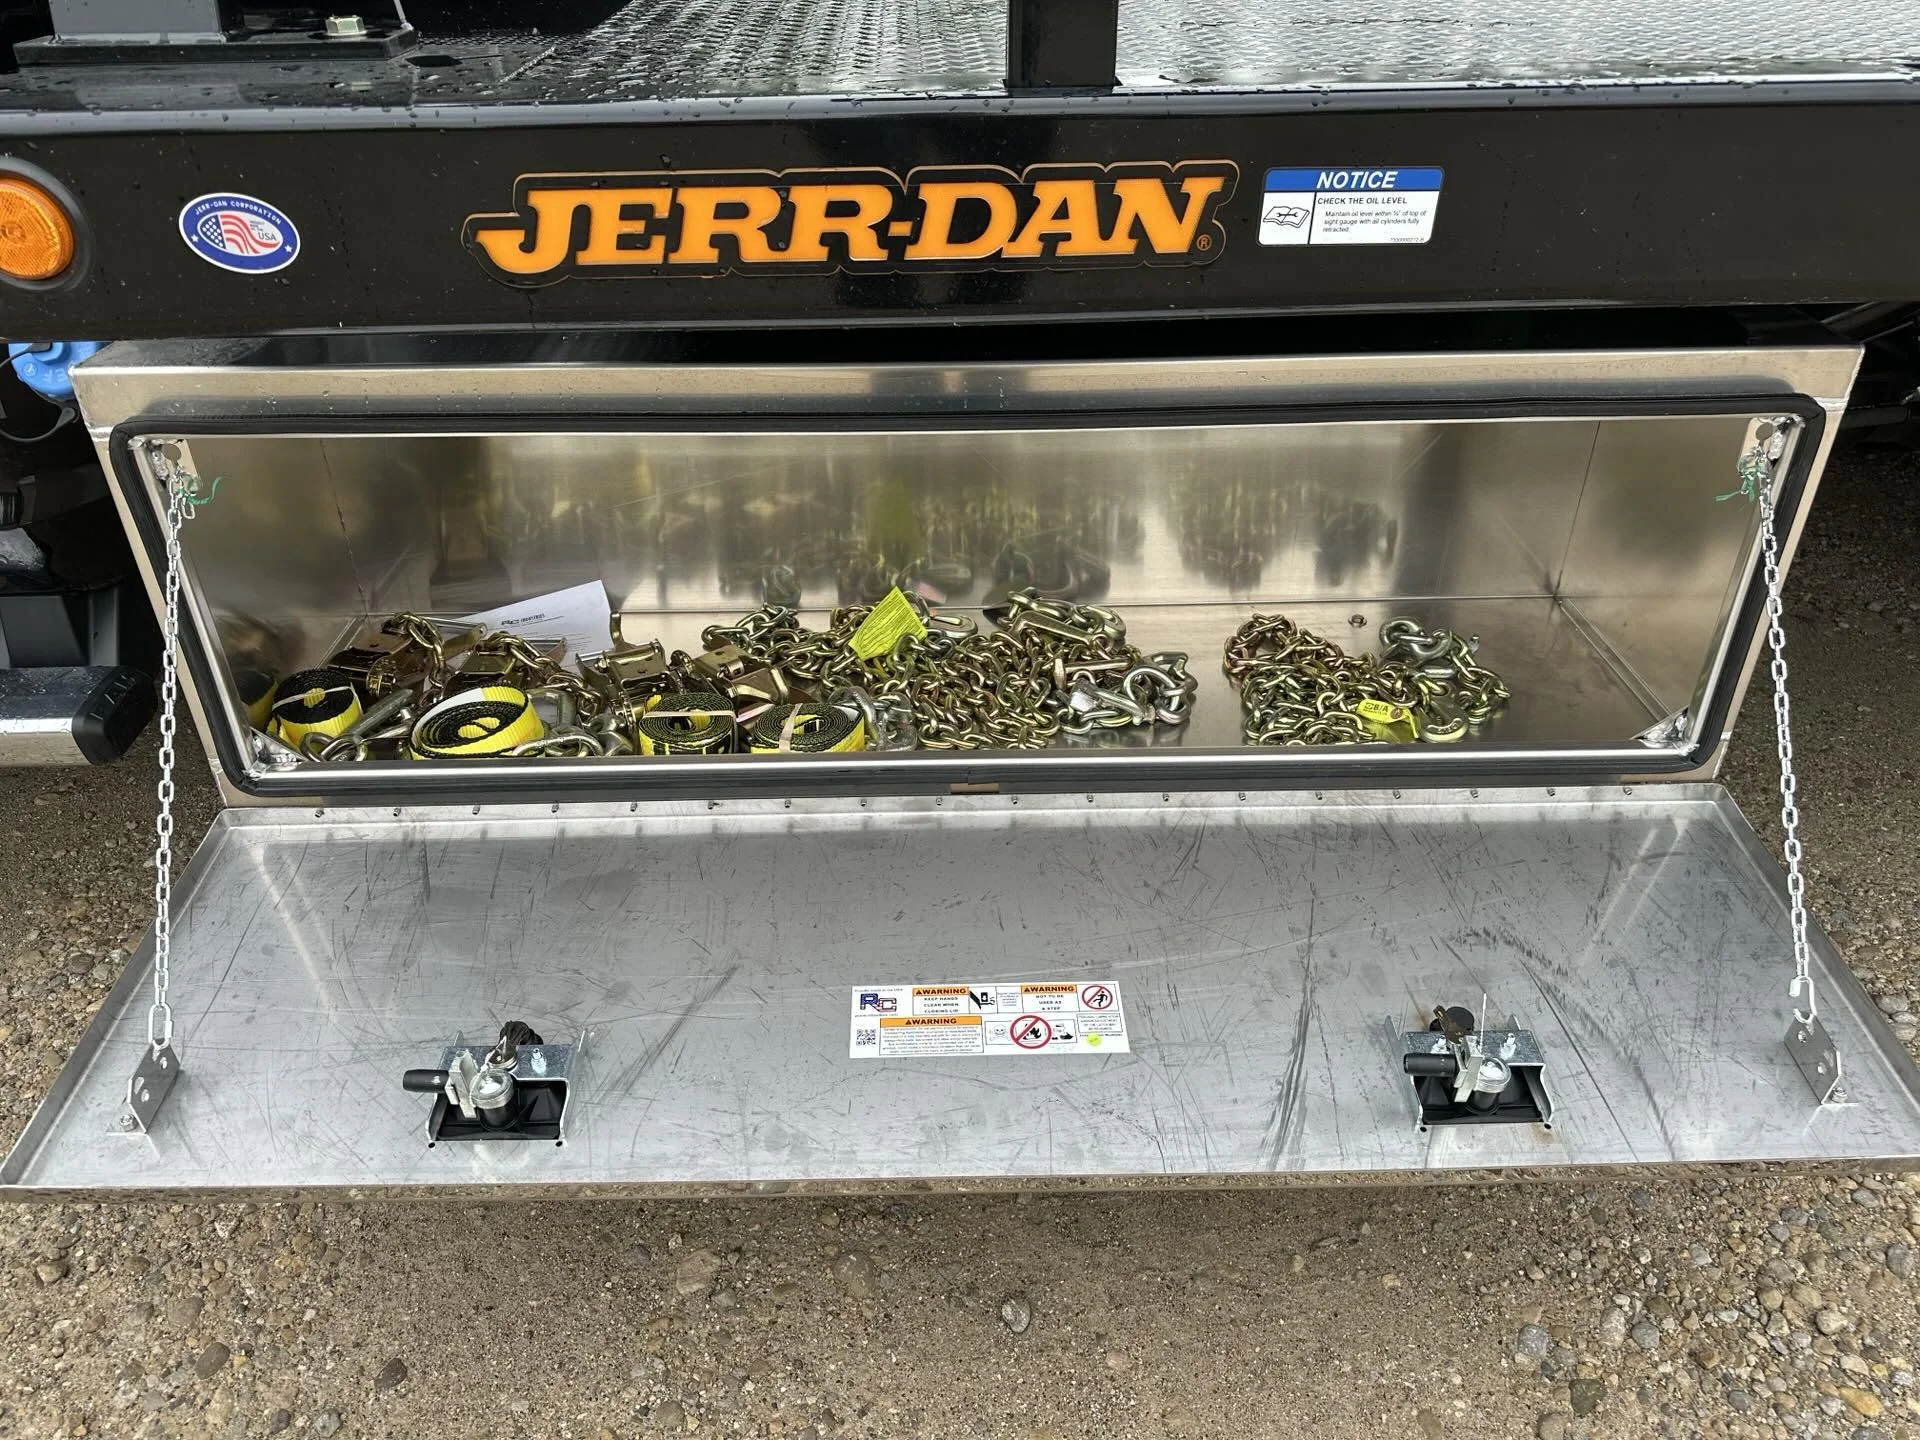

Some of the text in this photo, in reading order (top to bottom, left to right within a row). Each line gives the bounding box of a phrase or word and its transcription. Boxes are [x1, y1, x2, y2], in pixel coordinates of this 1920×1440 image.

[1316, 170, 1399, 189] NOTICE
[1317, 196, 1408, 205] CHECK THE OIL LEVEL
[195, 200, 282, 225] JERR-DAN CORPORATION
[1410, 210, 1419, 218] top
[1420, 209, 1427, 217] of
[475, 176, 1225, 275] JERR-DAN
[1324, 218, 1339, 226] sight
[1380, 218, 1407, 226] cylinders
[1407, 218, 1420, 226] fully
[258, 231, 277, 241] USA
[860, 992, 897, 1012] RC
[911, 1017, 957, 1025] WARNING
